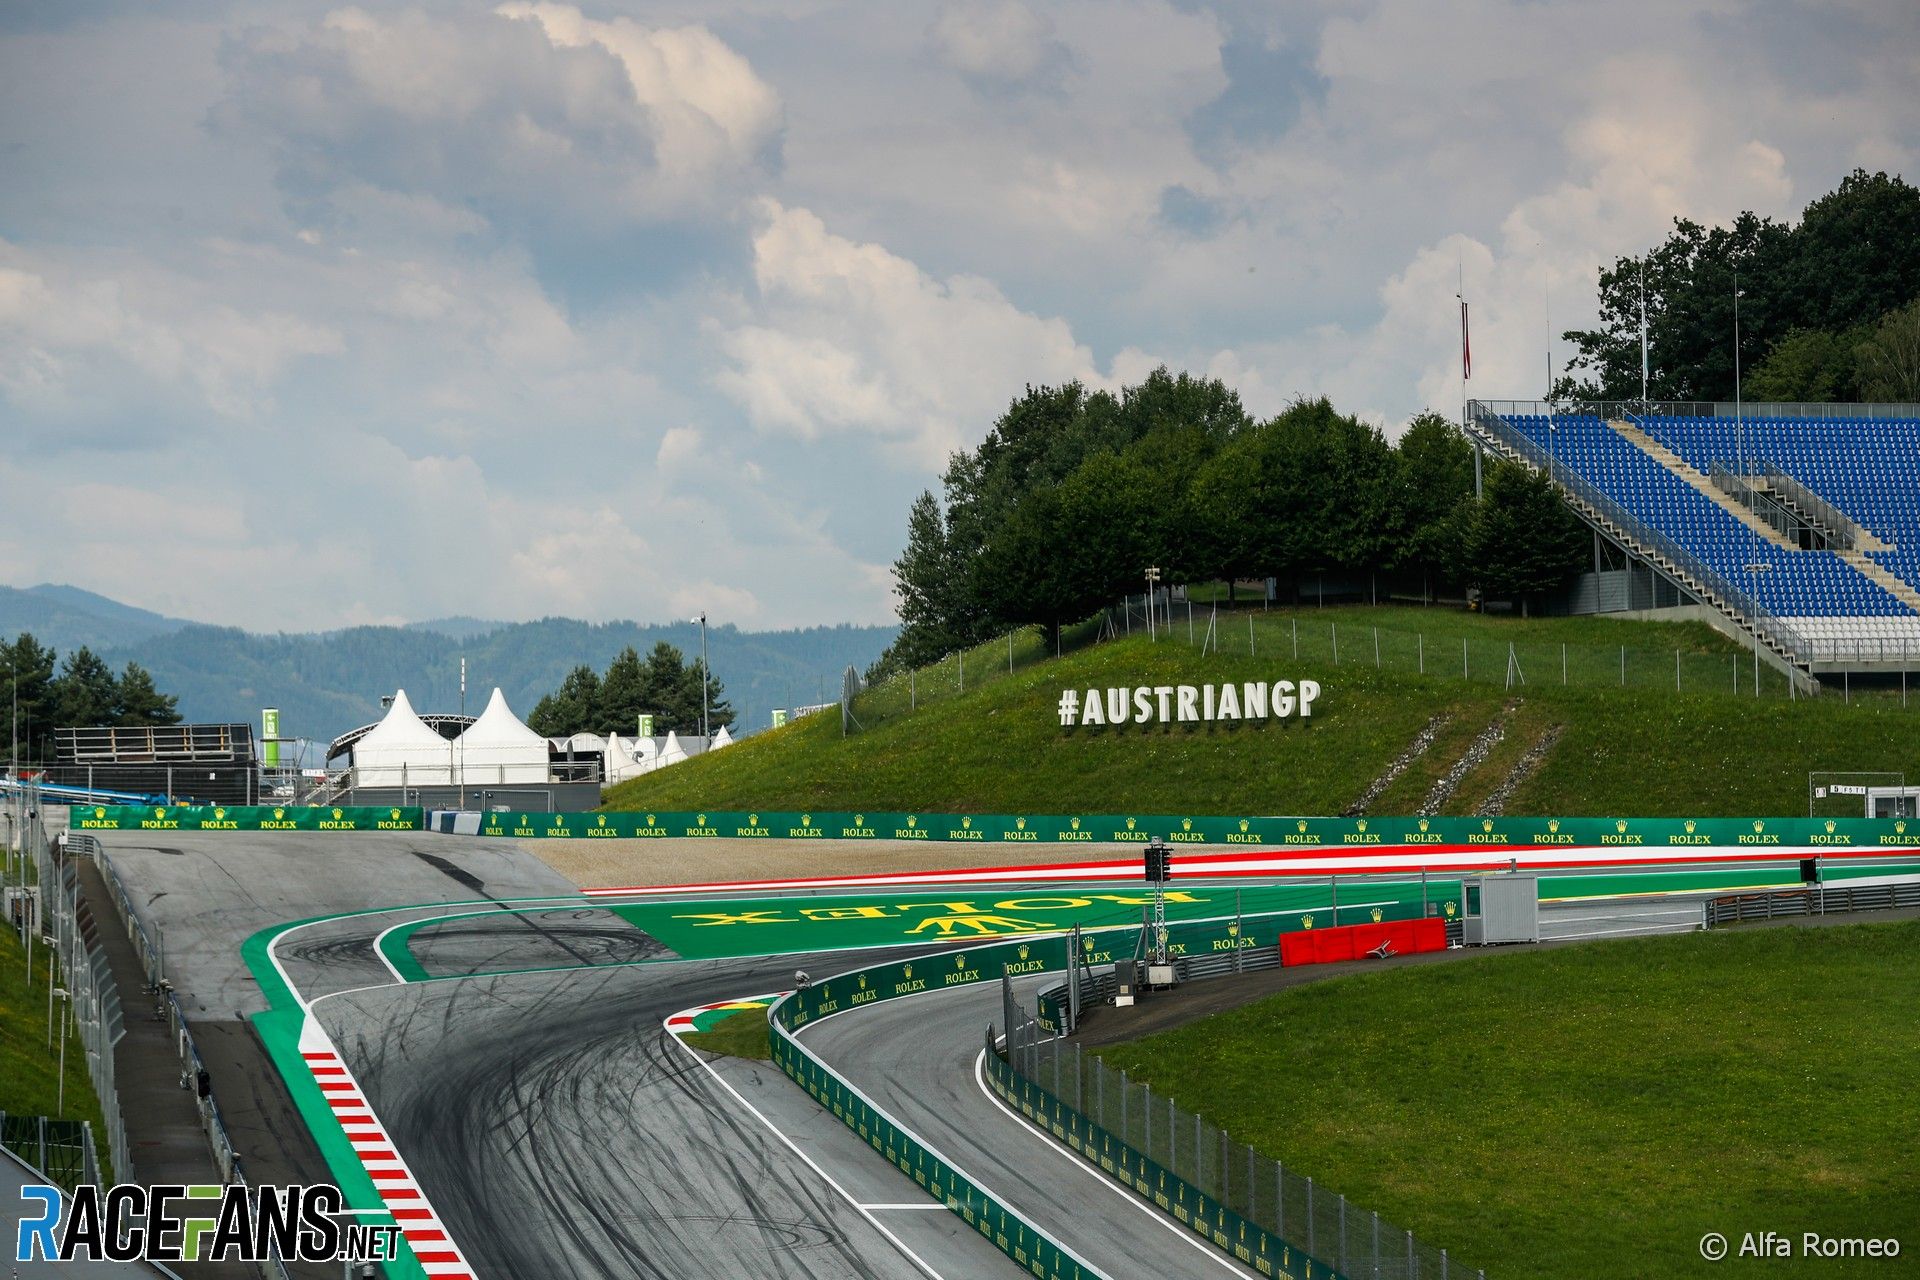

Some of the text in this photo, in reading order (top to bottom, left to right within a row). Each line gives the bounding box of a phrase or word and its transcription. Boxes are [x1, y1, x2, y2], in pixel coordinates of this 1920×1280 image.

[1058, 680, 1321, 725] #AUSTRIANGP
[82, 820, 117, 829] ROLEX
[142, 820, 177, 829] ROLEX
[202, 820, 237, 829] ROLEX
[261, 820, 296, 829] ROLEX
[320, 820, 355, 829] ROLEX
[378, 821, 412, 830] ROLEX
[486, 827, 503, 837] ROLEX
[515, 827, 534, 837] ROLEX
[636, 828, 666, 836] ROLEX
[686, 828, 717, 836] ROLEX
[738, 828, 769, 836] ROLEX
[896, 830, 928, 838] ROLEX
[950, 831, 982, 839] ROLEX
[1004, 832, 1037, 840] ROLEX
[1059, 832, 1092, 840] ROLEX
[1114, 832, 1148, 840] ROLEX
[1171, 833, 1204, 841] ROLEX
[1227, 834, 1261, 842] ROLEX
[1285, 835, 1320, 843] ROLEX
[1405, 834, 1442, 842] ROLEX
[1534, 835, 1574, 843] ROLEX
[1602, 835, 1642, 843] ROLEX
[1670, 836, 1711, 844] ROLEX
[1739, 835, 1779, 843] ROLEX
[1810, 834, 1850, 844] ROLEX
[1880, 835, 1920, 845] ROLEX
[1213, 936, 1256, 951] ROLEX
[1006, 960, 1044, 974] ROLEX
[945, 969, 980, 985] ROLEX
[895, 979, 925, 994] ROLEX
[851, 989, 877, 1004] ROLEX
